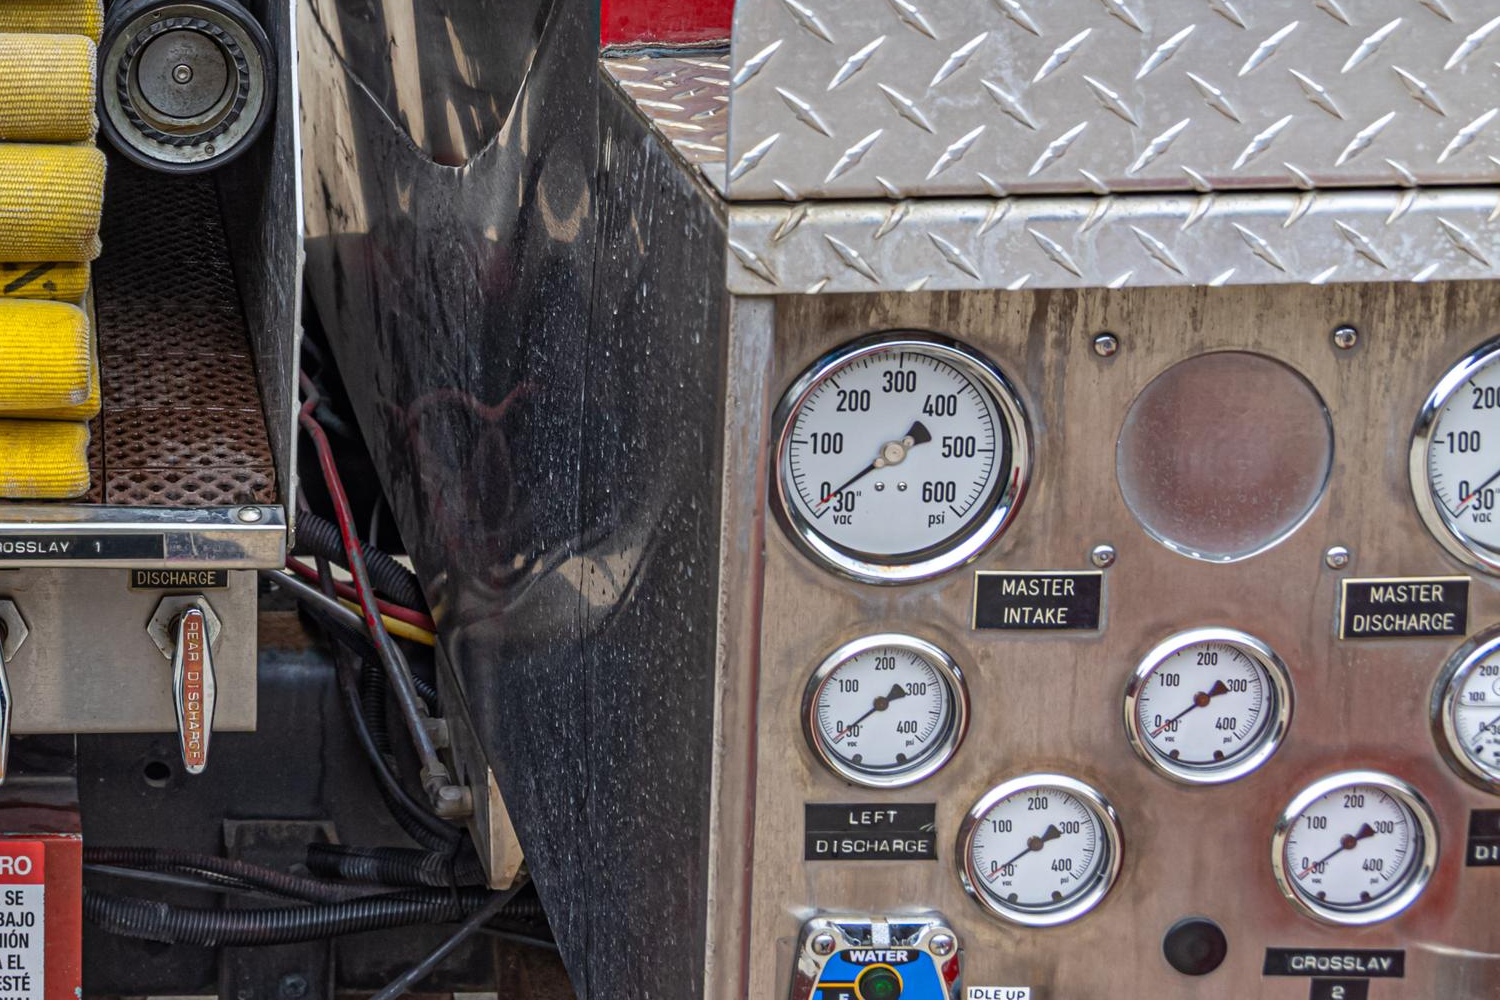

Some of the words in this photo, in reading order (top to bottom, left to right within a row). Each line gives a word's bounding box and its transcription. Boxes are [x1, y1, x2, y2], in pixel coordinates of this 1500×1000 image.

[883, 370, 916, 393] 300
[836, 390, 870, 412] 200
[922, 394, 957, 416] 400
[810, 433, 843, 454] 100
[942, 436, 975, 458] 500
[1447, 431, 1480, 452] 100
[821, 481, 831, 502] 0
[922, 481, 956, 503] 600
[833, 513, 852, 524] vac
[928, 511, 945, 528] psi
[1472, 512, 1492, 522] vac
[94, 541, 101, 552] 1
[136, 571, 216, 586] DISCHARGE
[1002, 578, 1075, 596] MASTER
[1370, 584, 1444, 603] MASTER
[1003, 607, 1068, 624] INTAKE
[1352, 613, 1455, 632] DISCHARGE
[186, 621, 199, 662] REAR
[875, 657, 895, 670] 200
[1197, 652, 1217, 666] 200
[1479, 665, 1499, 676] 200
[839, 679, 859, 692] 100
[1159, 674, 1180, 687] 100
[1227, 679, 1247, 692] 300
[906, 683, 926, 696] 300
[1468, 692, 1486, 701] 100
[186, 671, 201, 759] DISCHARGE
[897, 721, 917, 733] 400
[1215, 717, 1236, 730] 400
[1028, 797, 1048, 810] 200
[1344, 795, 1364, 808] 200
[849, 811, 898, 825] LEFT
[1306, 816, 1327, 829] 100
[992, 820, 1012, 833] 100
[1059, 821, 1079, 834] 300
[1374, 821, 1394, 833] 300
[816, 839, 929, 853] DISCHARGE
[1051, 858, 1071, 871] 400
[1362, 859, 1383, 871] 400
[5, 890, 24, 905] SE
[7, 955, 25, 970] EL
[849, 950, 908, 962] WATER
[1291, 955, 1393, 971] CROSSLAY
[969, 989, 1001, 1000] IDLE
[1005, 990, 1026, 1000] UP
[1331, 985, 1346, 1000] 2
